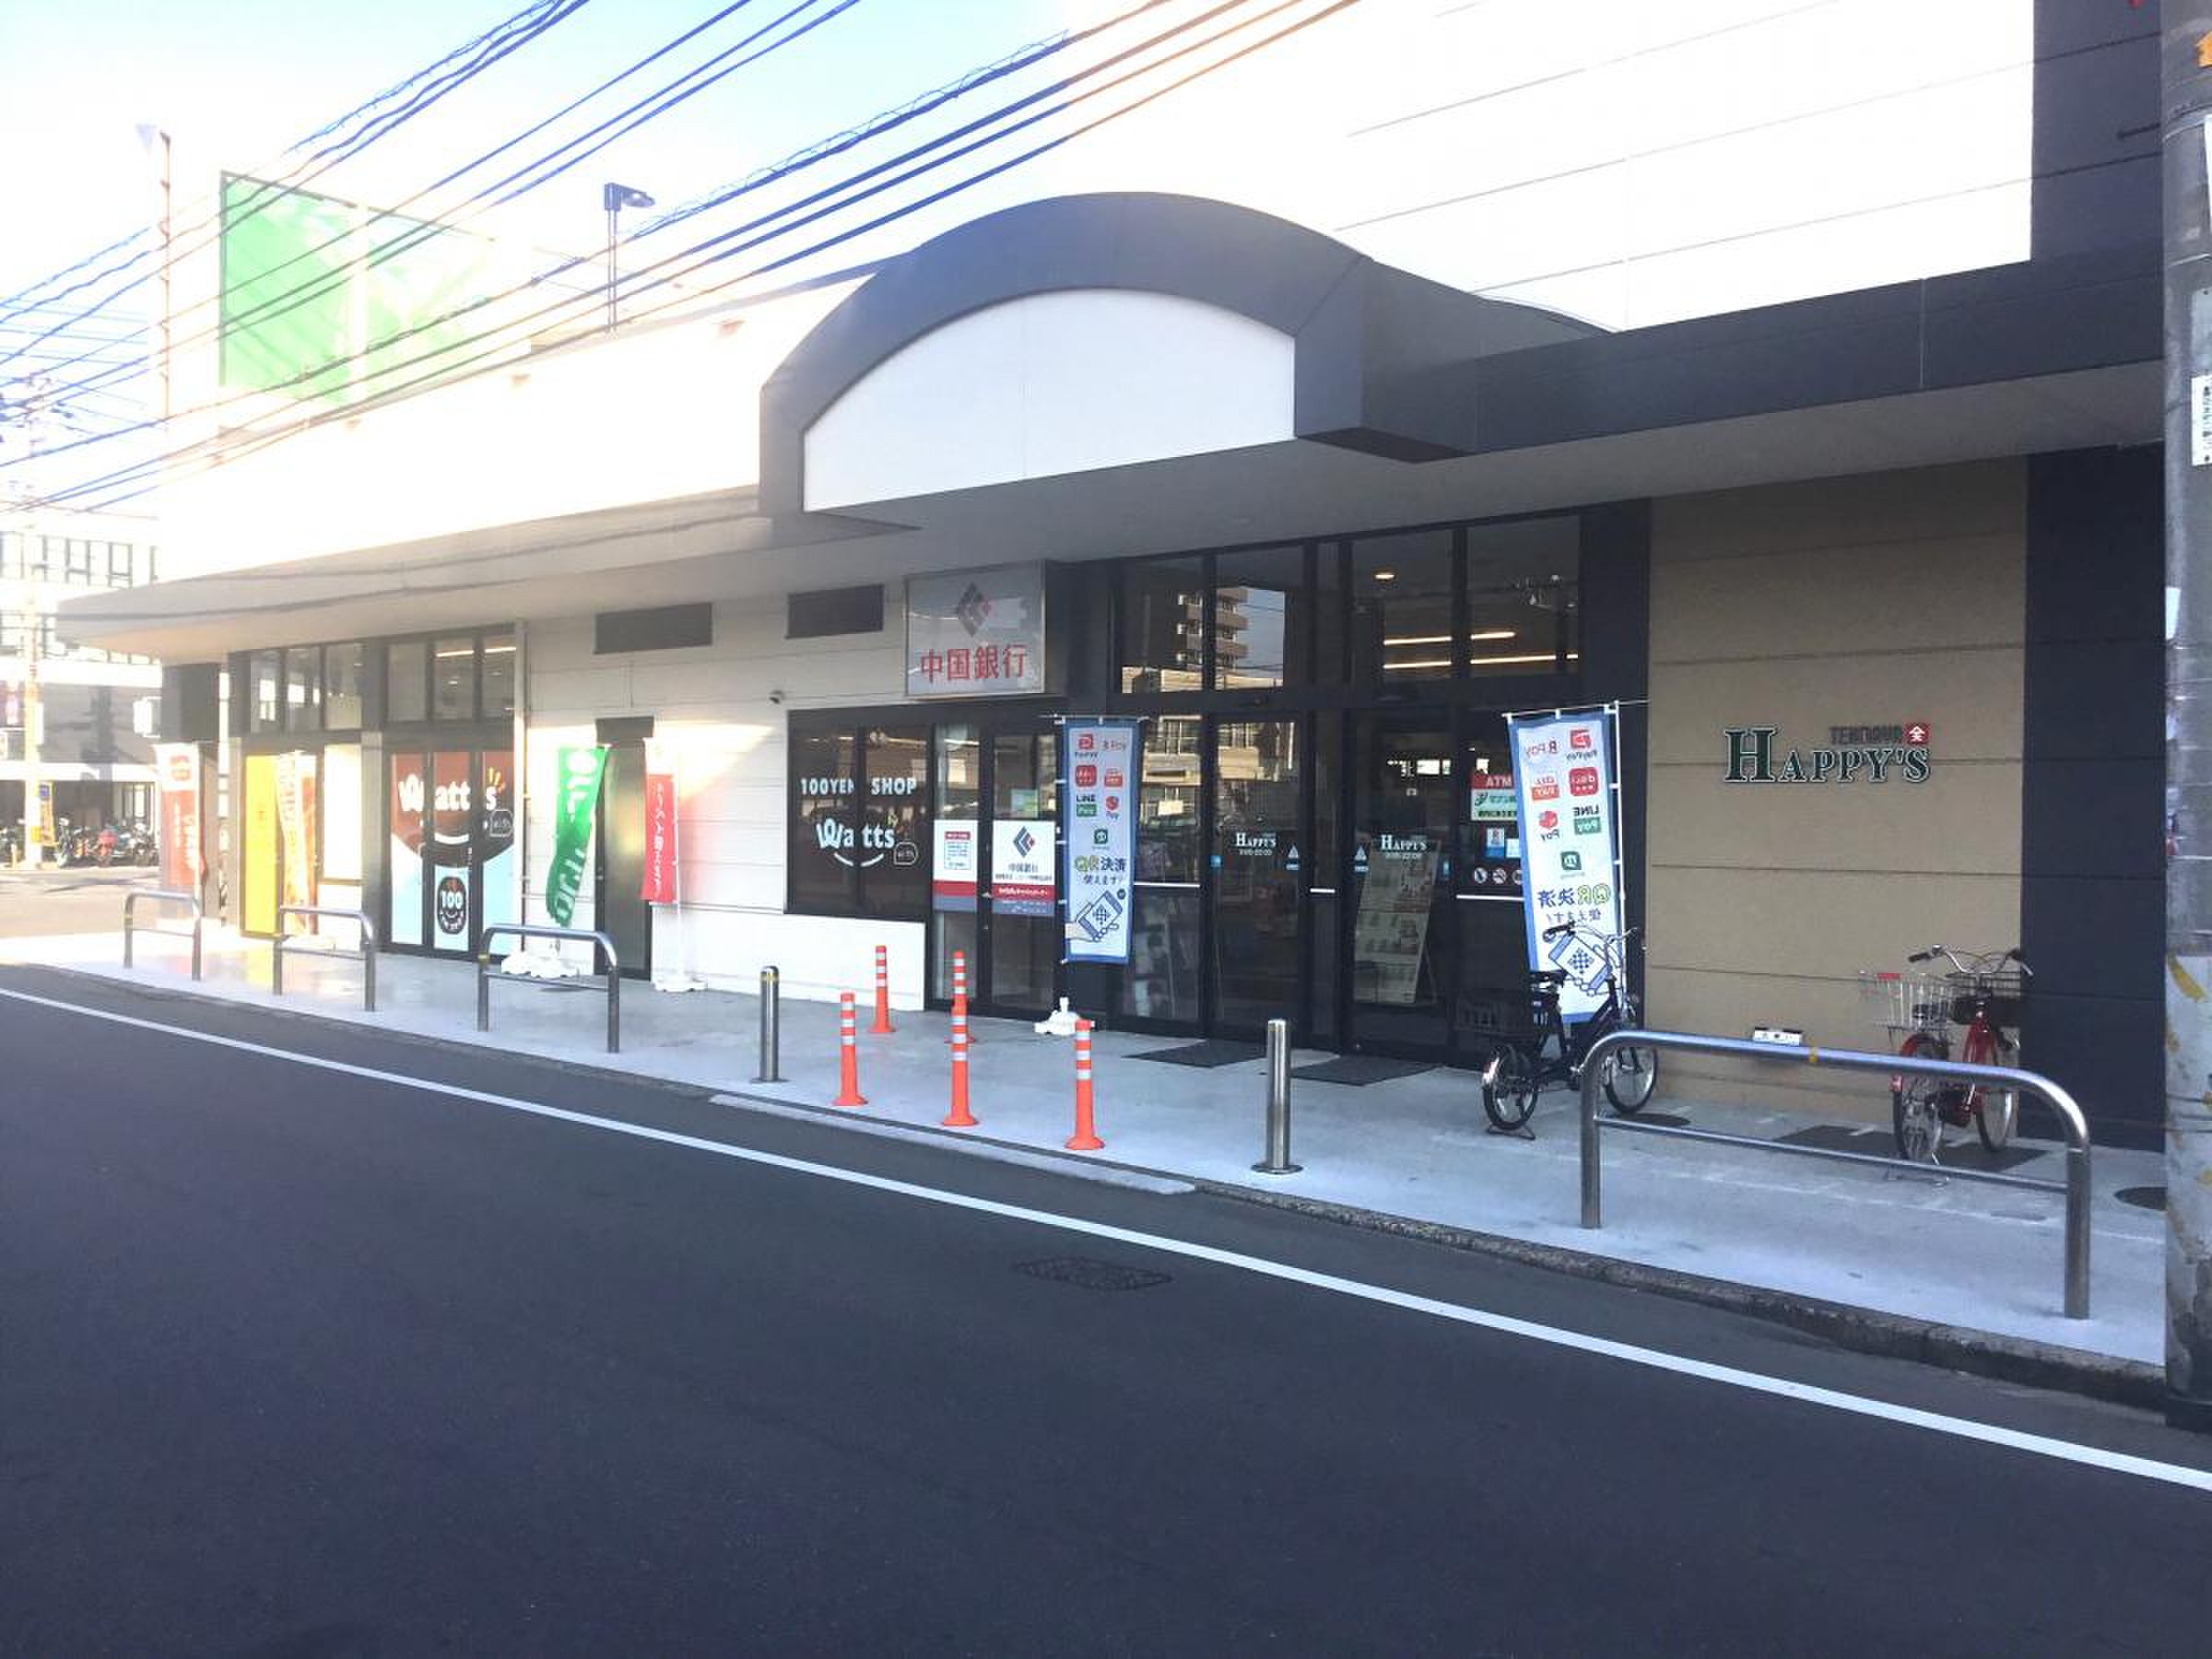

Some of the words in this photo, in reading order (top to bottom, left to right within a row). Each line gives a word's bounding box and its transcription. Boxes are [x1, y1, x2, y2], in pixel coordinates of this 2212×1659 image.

[921, 644, 1029, 682] 中国銀行
[1724, 726, 1932, 783] HAPPY'S
[870, 777, 917, 795] SHOP
[1487, 776, 1512, 788] ATM
[1076, 794, 1096, 803] LINE
[816, 818, 895, 849] Watts
[441, 890, 464, 910] 100
